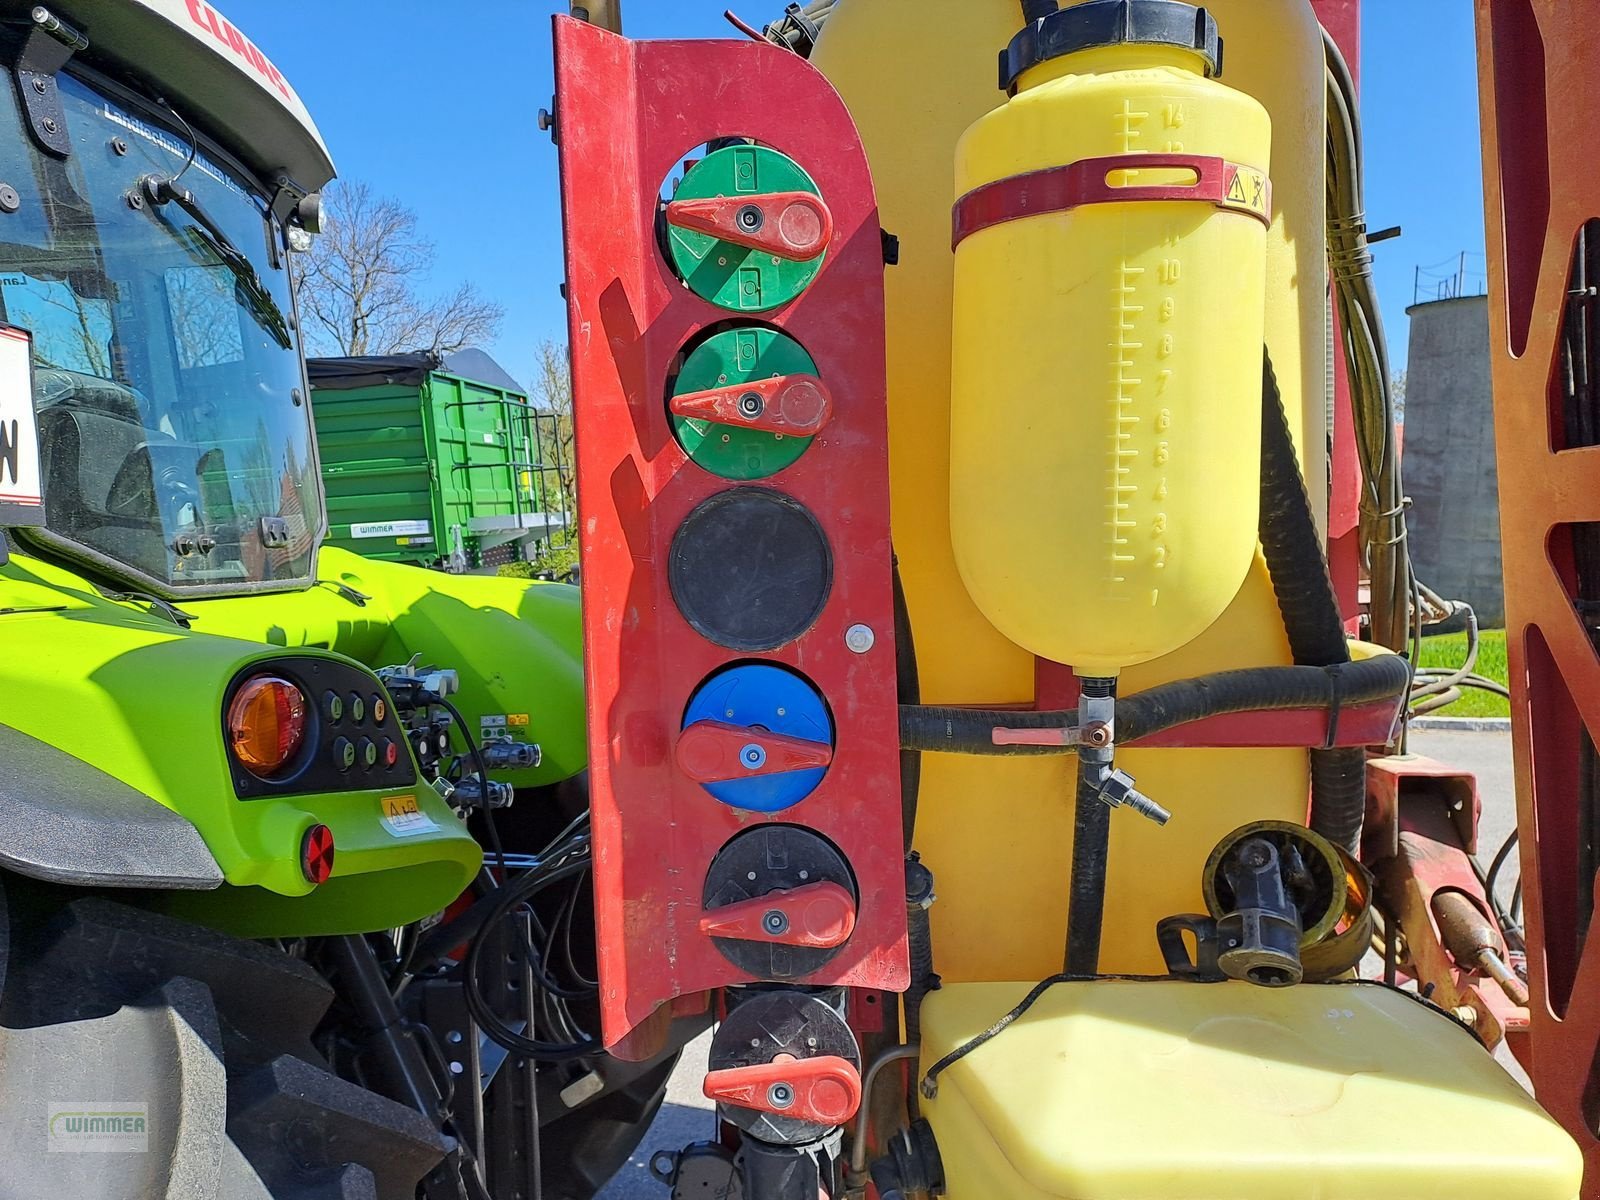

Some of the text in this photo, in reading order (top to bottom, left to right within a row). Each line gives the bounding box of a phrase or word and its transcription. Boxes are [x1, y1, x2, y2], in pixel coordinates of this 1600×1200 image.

[184, 0, 291, 101] CLAAS
[104, 103, 185, 160] Landtechnik
[1163, 258, 1181, 282] 10
[1162, 297, 1175, 318] 9
[1163, 333, 1173, 354] 8
[1160, 407, 1171, 429] 6
[1158, 440, 1169, 464] 5
[360, 525, 394, 534] WIMMER
[1154, 512, 1167, 534] 3
